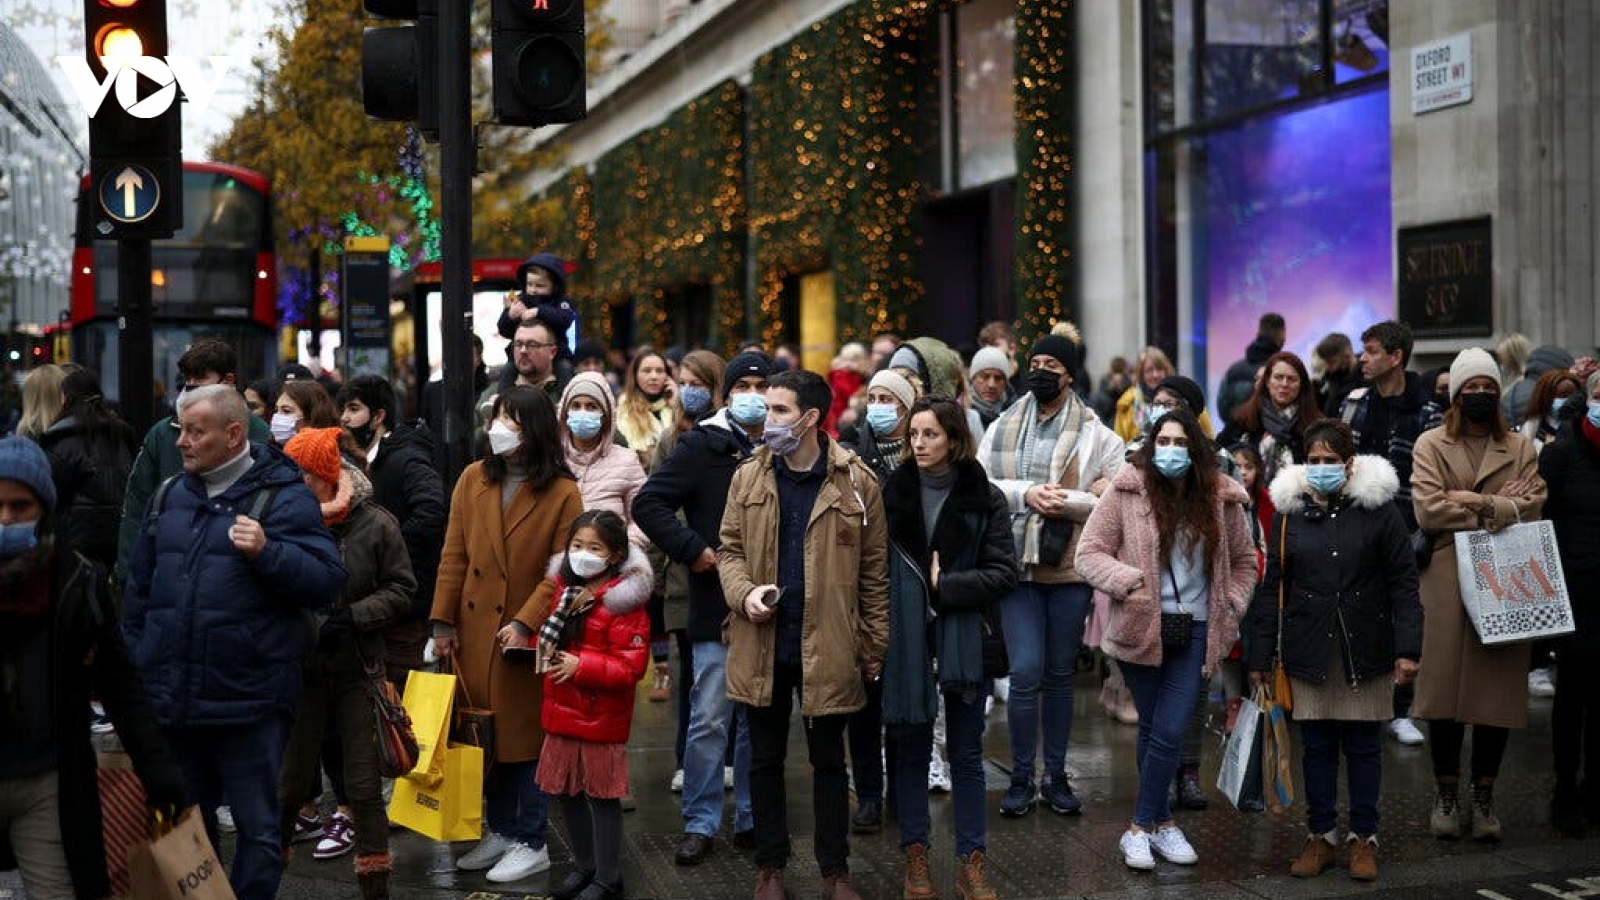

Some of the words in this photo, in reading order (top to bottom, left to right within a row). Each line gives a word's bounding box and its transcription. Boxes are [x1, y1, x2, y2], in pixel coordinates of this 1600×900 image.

[1416, 45, 1450, 70] OXFORD
[1416, 66, 1448, 90] STREET
[1452, 62, 1465, 79] W1
